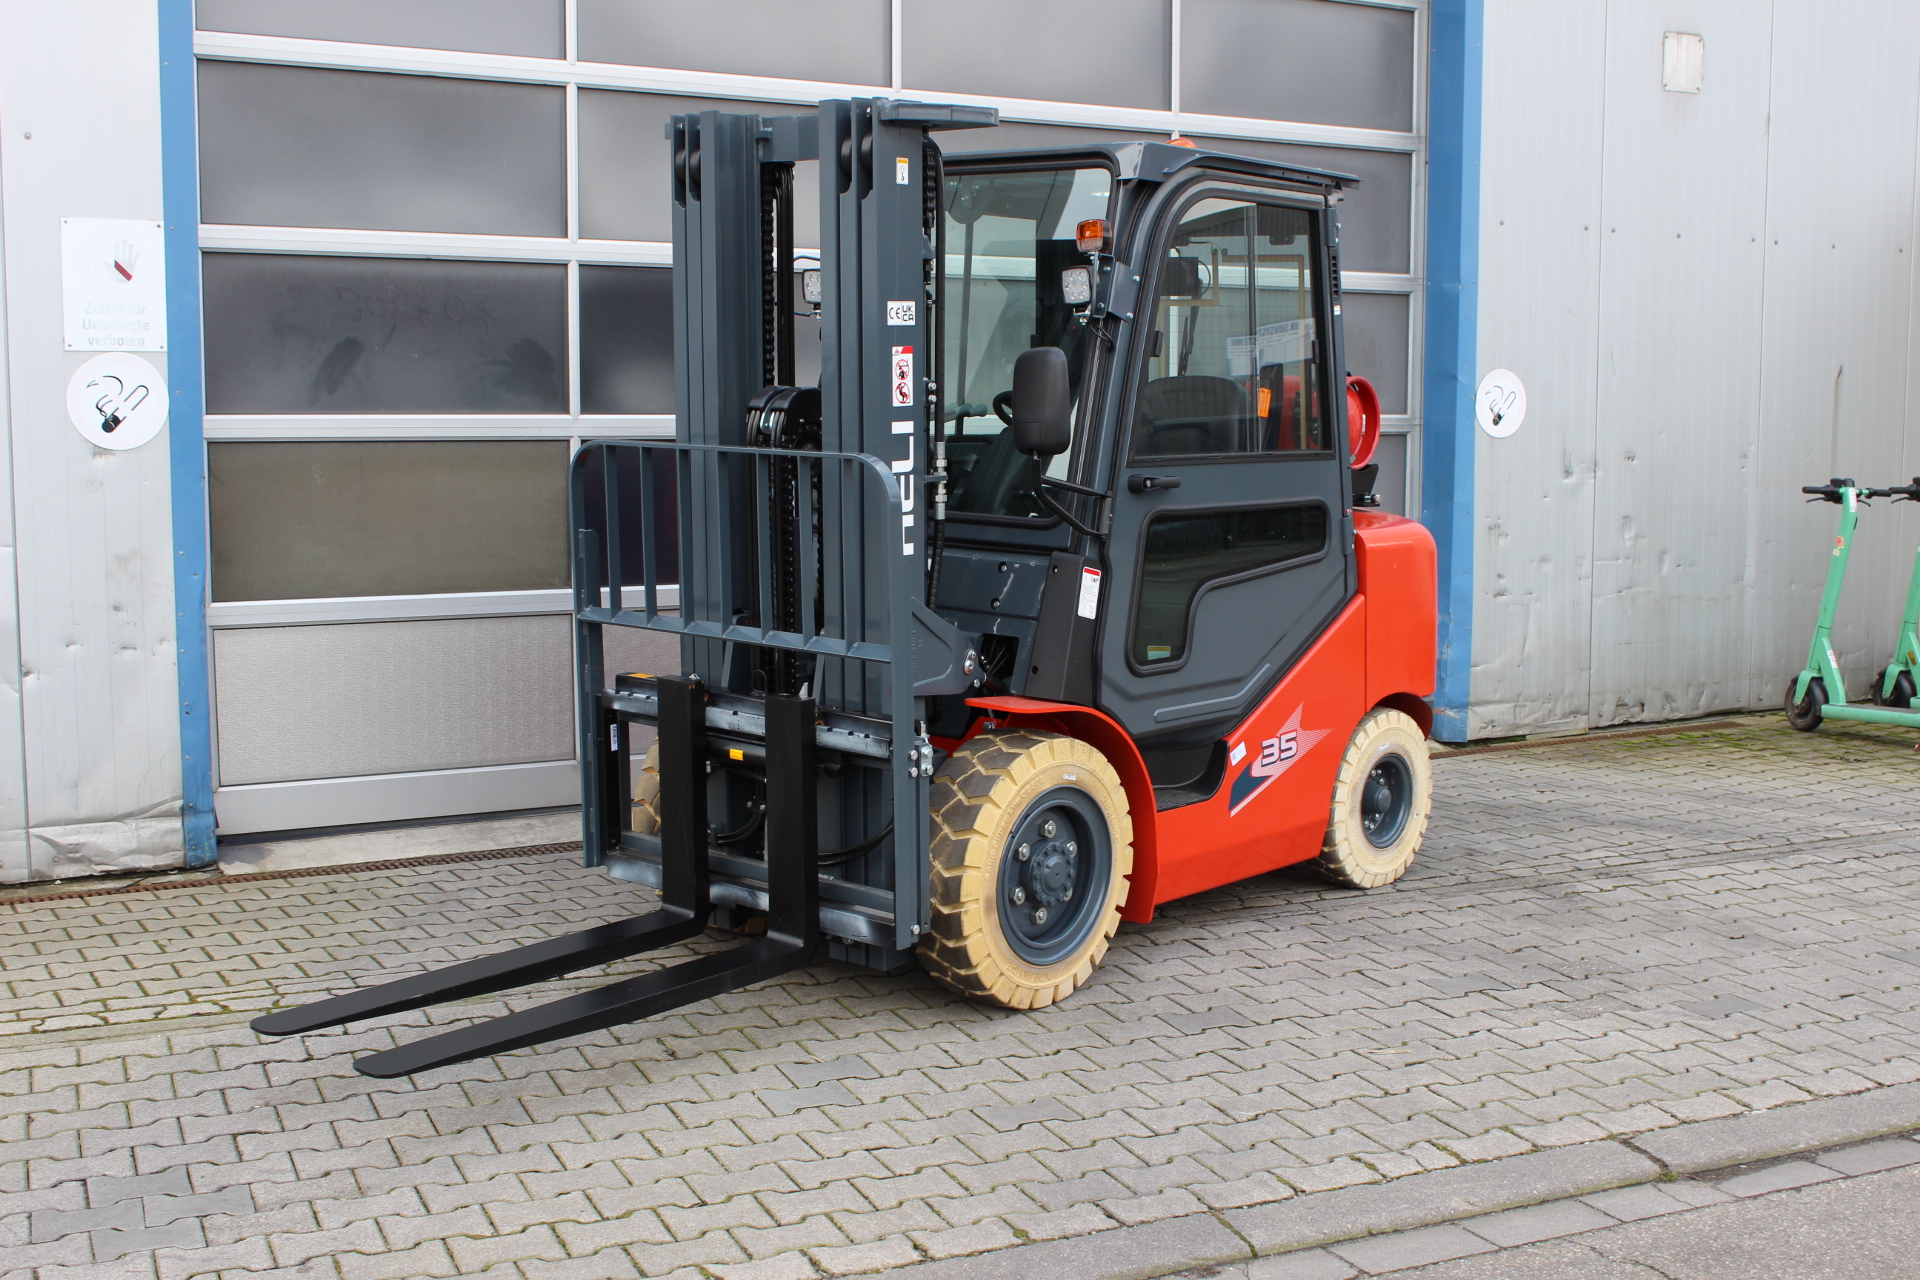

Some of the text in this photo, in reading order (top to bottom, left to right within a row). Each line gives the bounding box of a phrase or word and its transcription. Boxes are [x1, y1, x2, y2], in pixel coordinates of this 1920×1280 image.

[85, 302, 147, 315] Zutritt für
[889, 307, 901, 320] CE
[903, 305, 913, 313] UK
[82, 318, 150, 333] Unbefugte
[87, 334, 145, 347] verboten
[1261, 731, 1298, 767] 35
